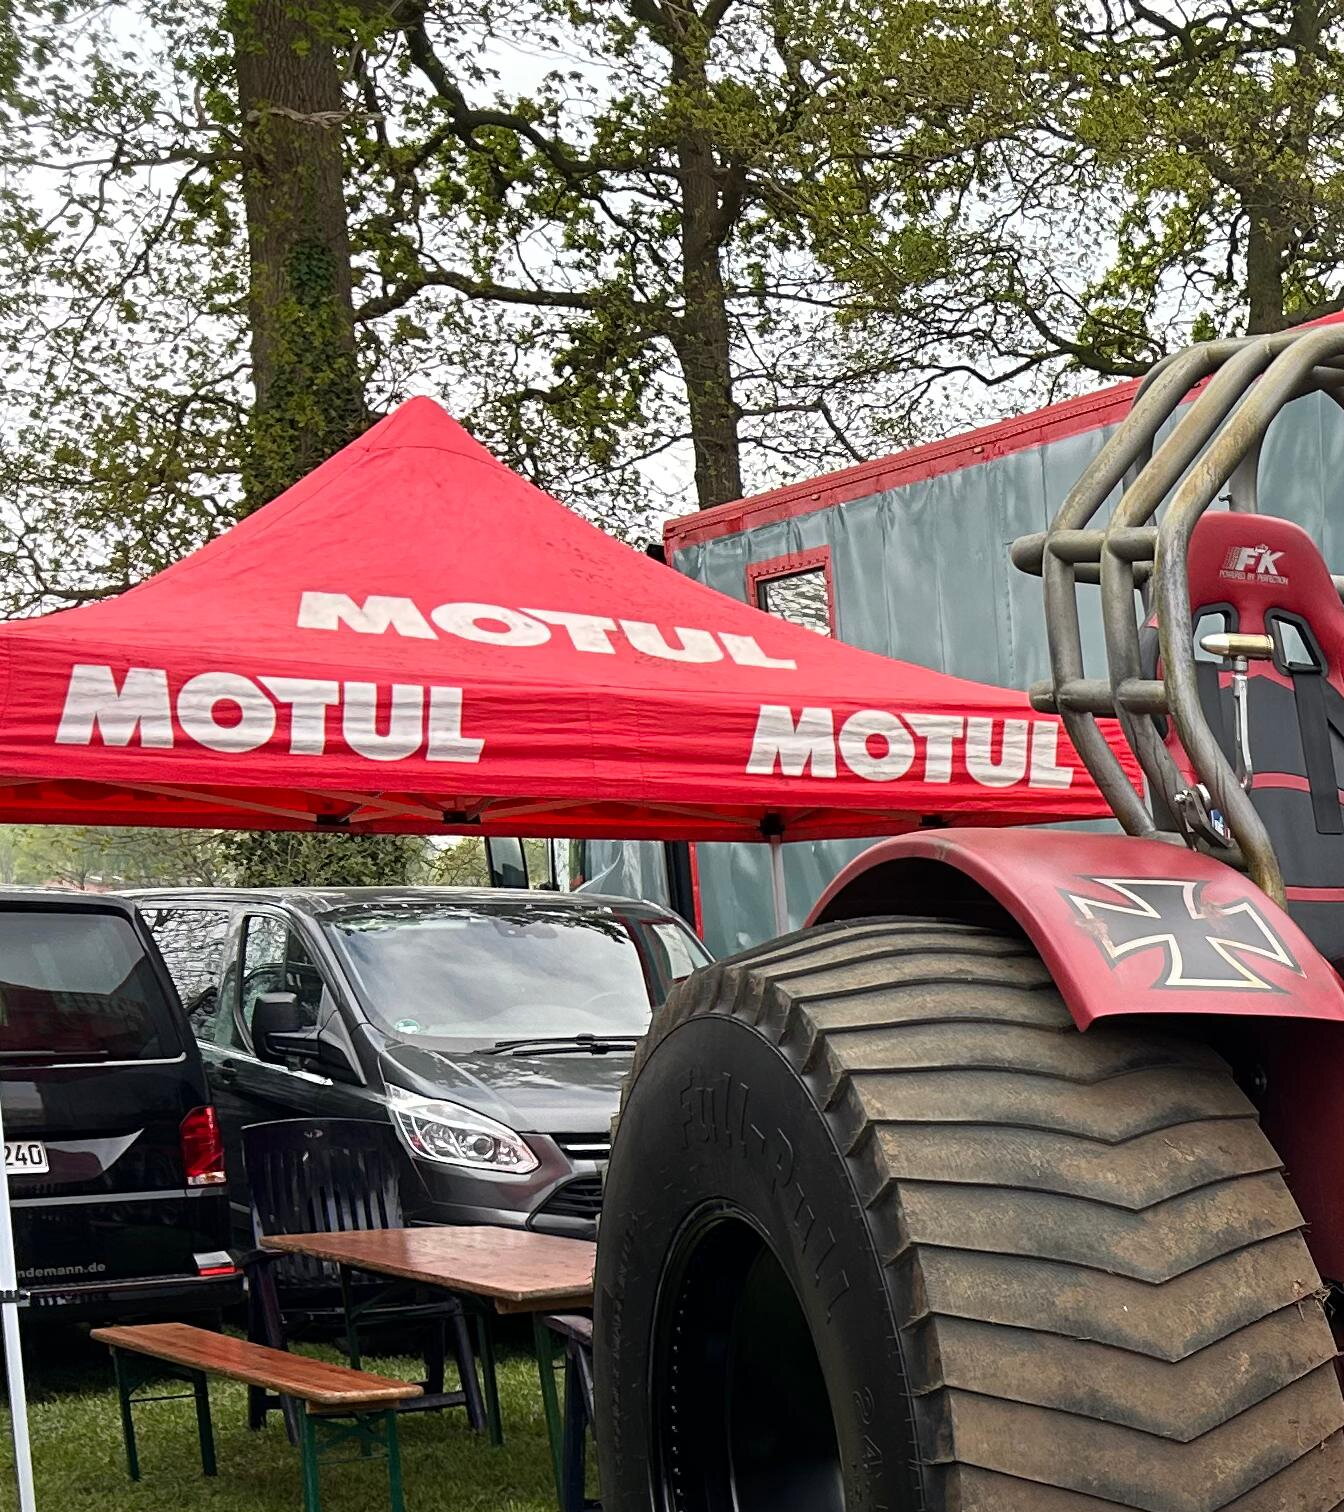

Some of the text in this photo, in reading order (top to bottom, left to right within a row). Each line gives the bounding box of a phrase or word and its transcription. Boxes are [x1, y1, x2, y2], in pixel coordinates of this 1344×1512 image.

[1234, 547, 1286, 575] FK
[297, 591, 798, 669] MOTUL
[56, 663, 485, 763] MOTUL
[746, 704, 1075, 789] MOTUL
[16, 1261, 106, 1279] ndemann.de
